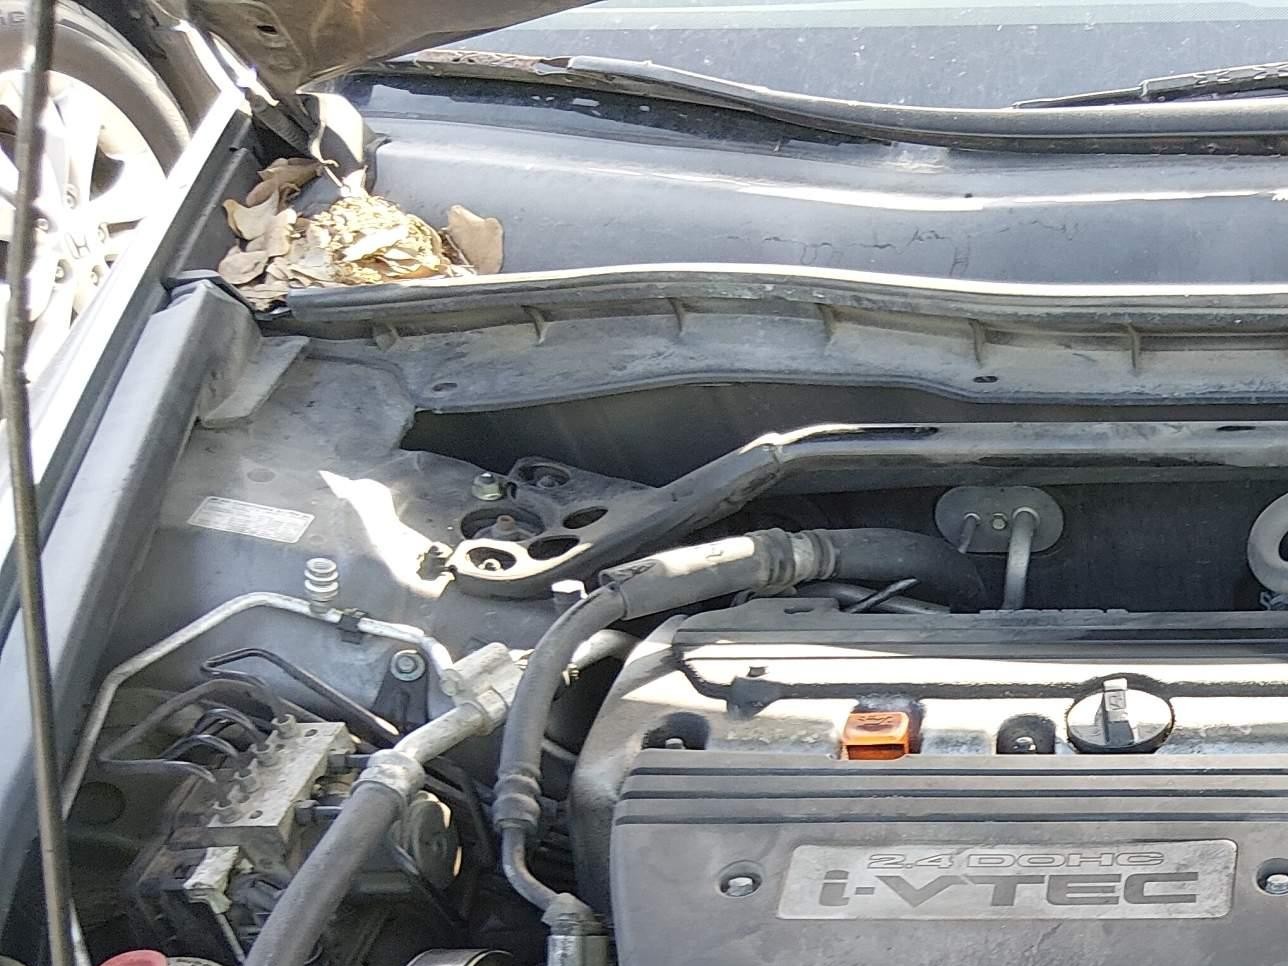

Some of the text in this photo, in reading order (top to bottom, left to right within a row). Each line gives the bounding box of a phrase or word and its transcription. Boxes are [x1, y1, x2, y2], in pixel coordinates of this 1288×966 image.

[866, 851, 1165, 870] 2.4 DOHC
[818, 869, 1199, 908] i-VTEC
